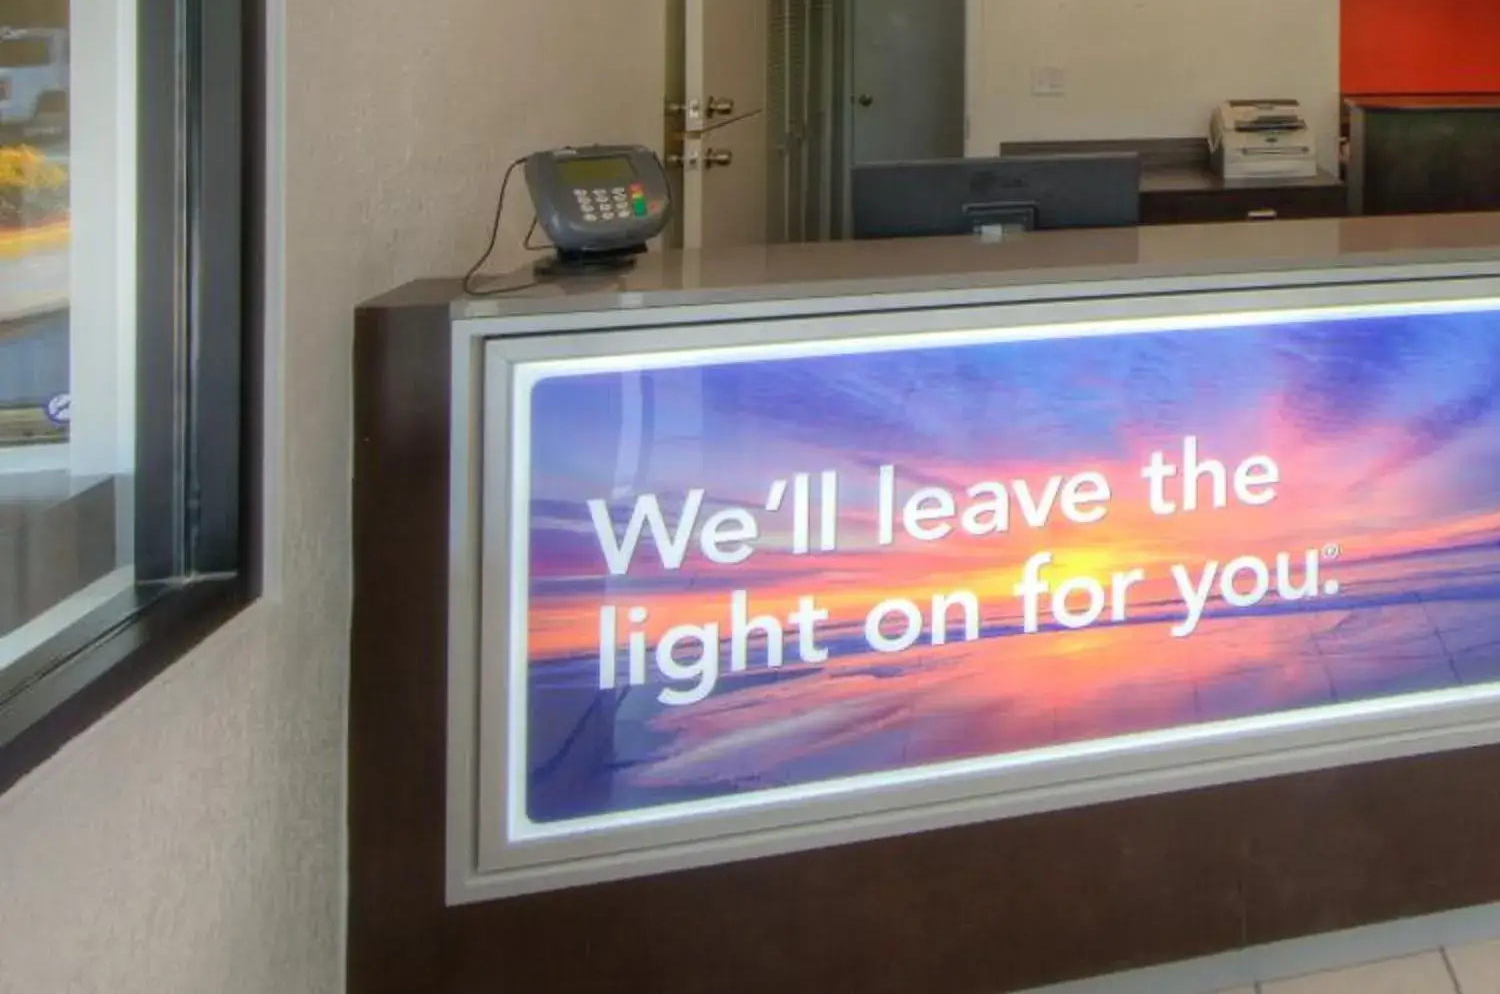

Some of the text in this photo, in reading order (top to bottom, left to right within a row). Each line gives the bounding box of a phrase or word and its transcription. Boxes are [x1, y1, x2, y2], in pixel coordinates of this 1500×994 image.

[587, 436, 1281, 575] We'll leave the
[600, 589, 828, 705] light
[865, 589, 978, 653] on
[1014, 552, 1143, 634] for
